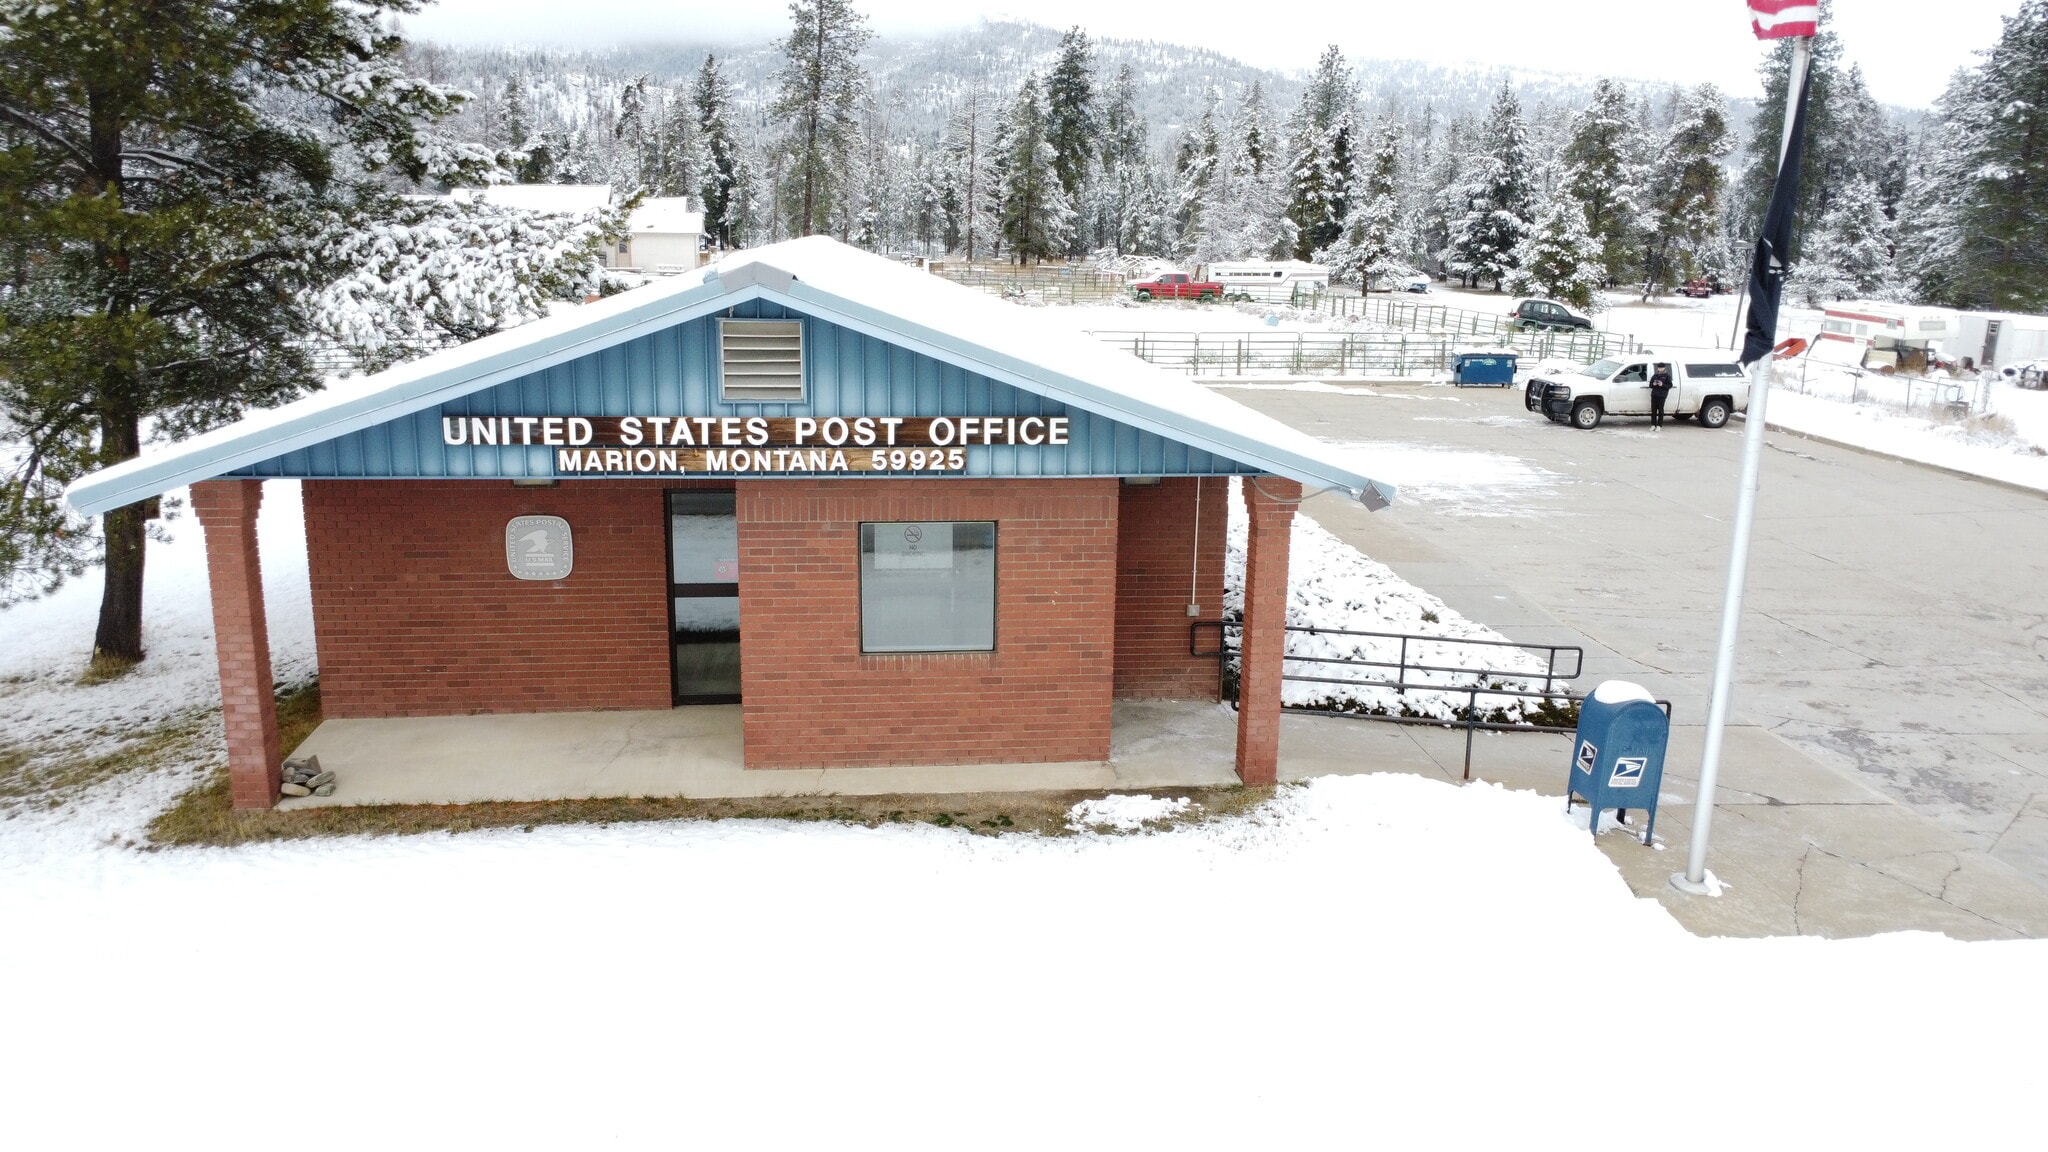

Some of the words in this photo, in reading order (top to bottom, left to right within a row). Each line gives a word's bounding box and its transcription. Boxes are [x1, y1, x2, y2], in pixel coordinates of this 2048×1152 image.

[442, 417, 593, 446] UNITED
[620, 416, 769, 446] STATES
[795, 417, 903, 446] POST
[928, 416, 1069, 446] OFFICE
[558, 449, 685, 473] MARION,
[706, 449, 849, 472] MONTANA
[871, 449, 964, 471] 59925
[510, 519, 534, 532] STATES
[536, 519, 565, 531] POSTAL
[509, 534, 517, 563] UNITED
